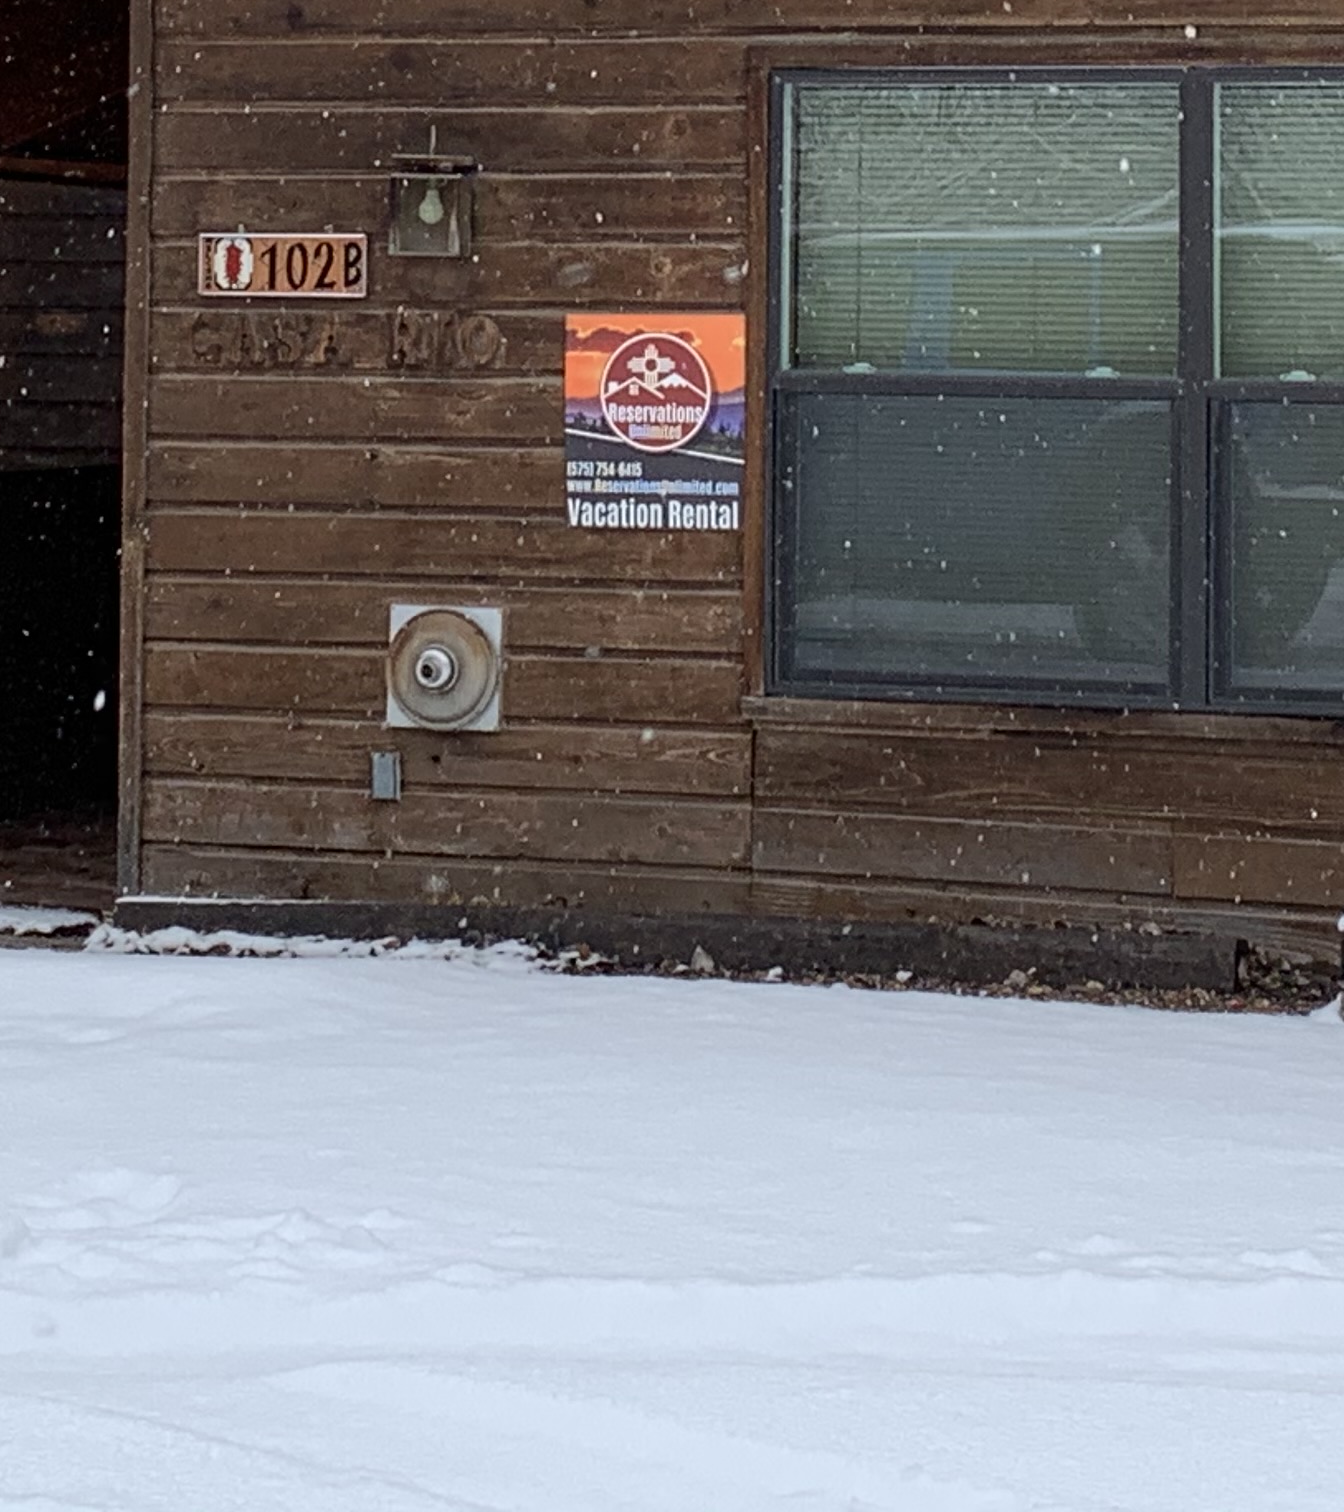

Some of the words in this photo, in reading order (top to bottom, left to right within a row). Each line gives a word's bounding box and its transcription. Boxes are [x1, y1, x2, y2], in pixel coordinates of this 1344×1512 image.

[259, 241, 363, 291] 102B
[609, 402, 703, 423] Reservations
[628, 424, 682, 439] Unlimited
[567, 497, 664, 528] Vacation
[667, 499, 740, 530] Rental
